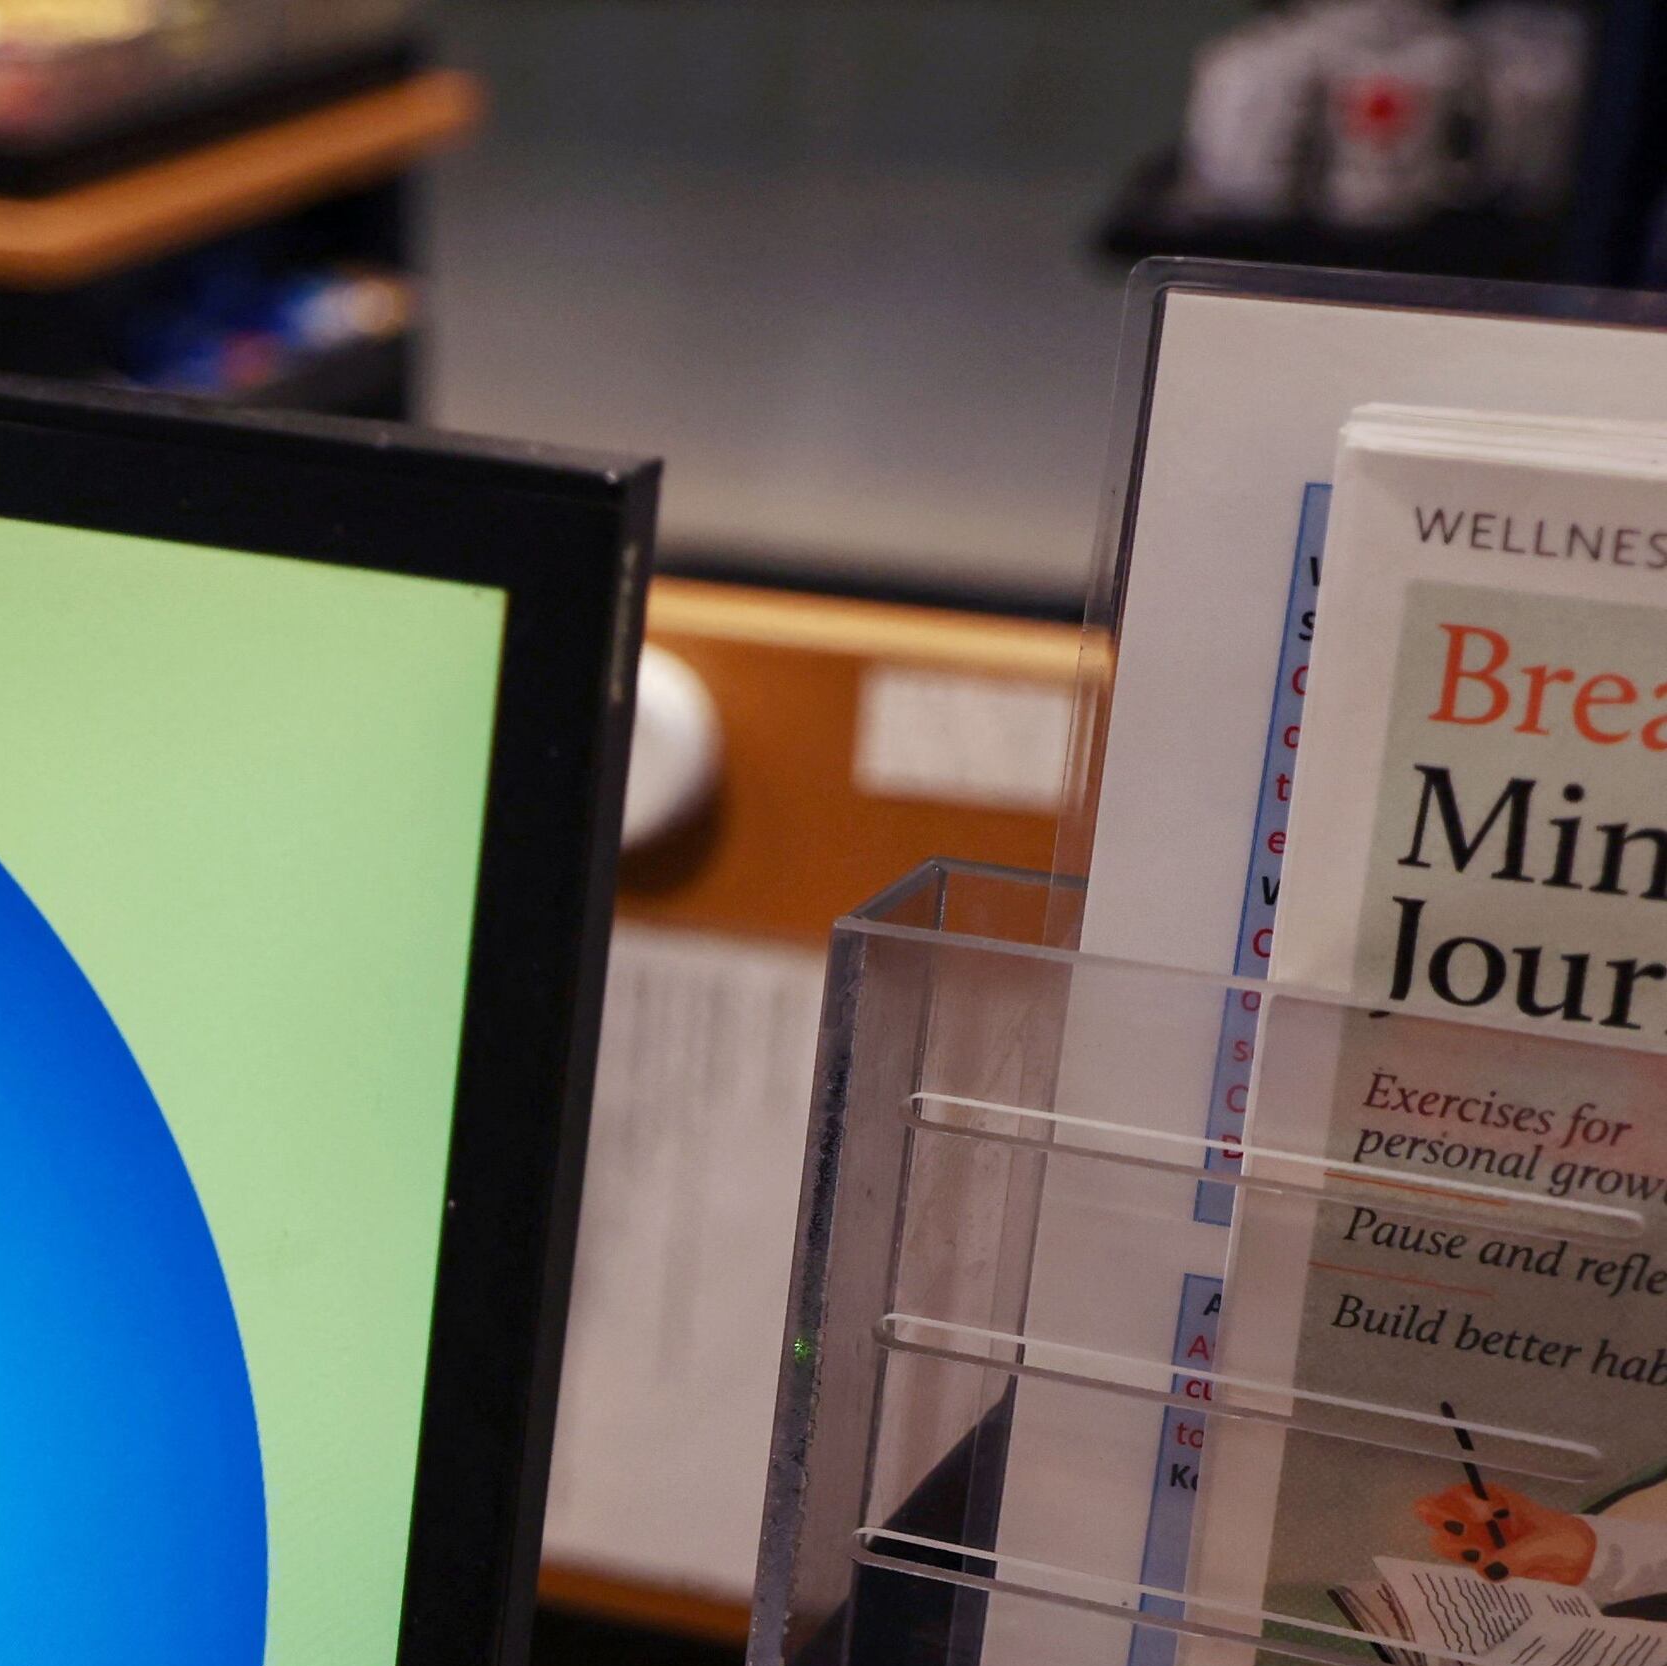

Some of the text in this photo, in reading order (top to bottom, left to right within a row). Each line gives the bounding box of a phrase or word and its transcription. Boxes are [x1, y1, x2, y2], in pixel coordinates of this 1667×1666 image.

[1415, 505, 1667, 570] WELLNES
[1397, 763, 1667, 902] Min
[1369, 895, 1667, 1030] Jour
[1362, 1071, 1633, 1149] Exercises for
[1353, 1127, 1667, 1205] personal grow
[1343, 1205, 1667, 1299] Pause and refle
[1331, 1293, 1448, 1346] Build
[1454, 1313, 1583, 1369] better
